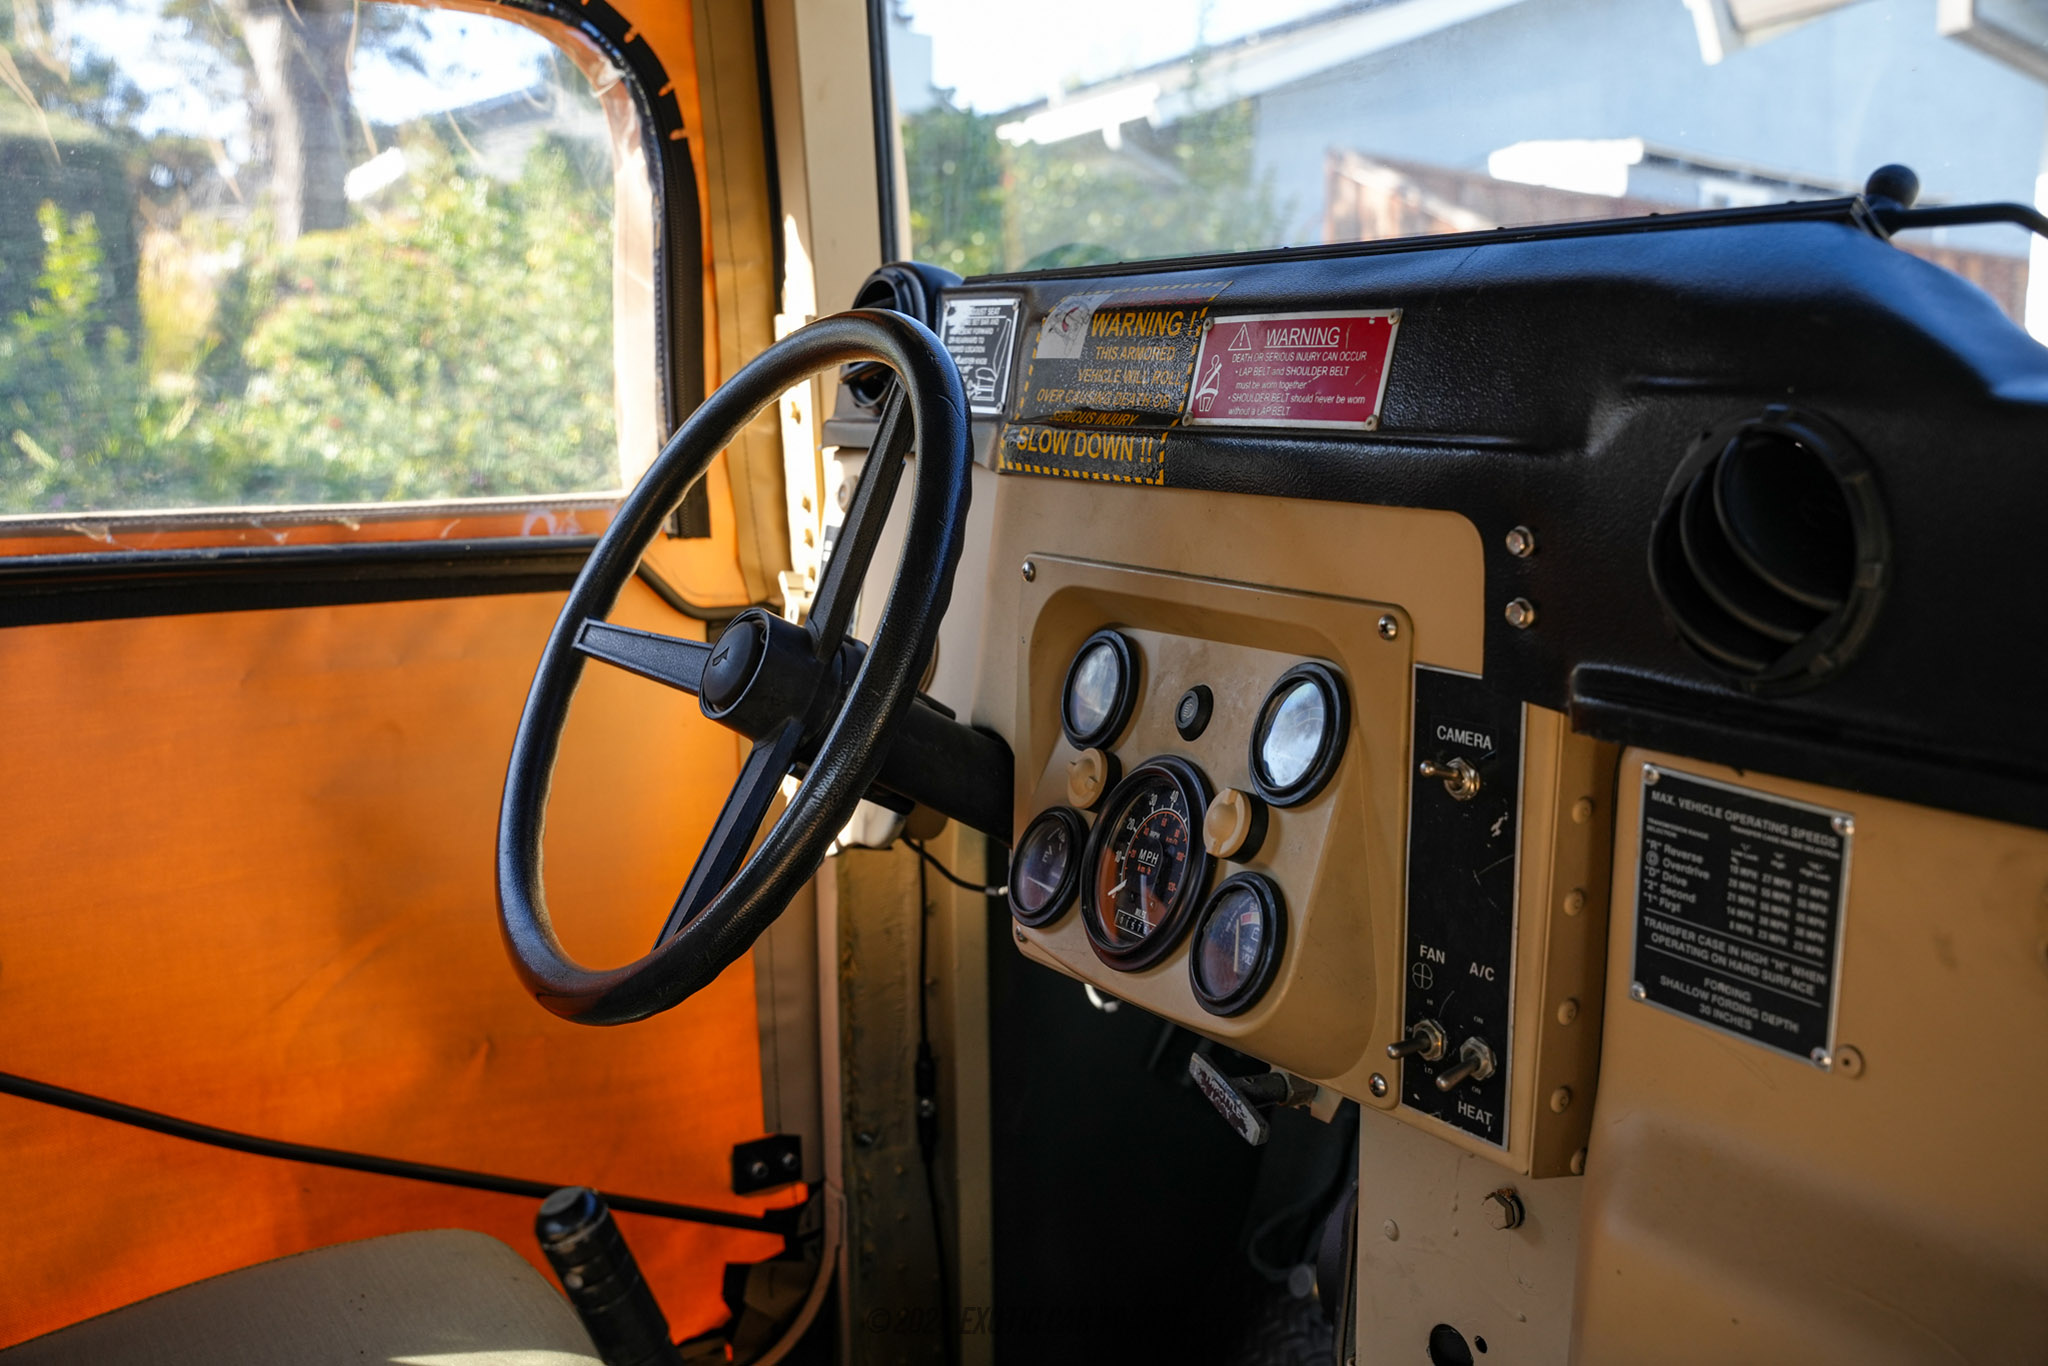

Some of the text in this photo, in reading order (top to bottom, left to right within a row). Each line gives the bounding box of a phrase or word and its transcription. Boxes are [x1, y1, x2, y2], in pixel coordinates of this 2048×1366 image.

[1091, 311, 1184, 337] WARNING
[1266, 327, 1340, 346] WARNING
[1095, 346, 1176, 361] THIS ARMORED
[1232, 351, 1368, 363] DEATH OR SERIOUS INJURY CAN OCCUR
[1078, 369, 1183, 385] VEHICLE WILL ROLL
[1253, 367, 1271, 376] BELT
[1271, 367, 1286, 376] and
[1285, 366, 1328, 376] SHOULDER
[1329, 366, 1350, 376] BELT
[1235, 381, 1251, 390] must
[1251, 381, 1260, 389] be
[1279, 381, 1307, 391] together
[1036, 388, 1171, 408] OVER CAUSING DEATH OR
[1270, 393, 1290, 403] BELT
[1290, 393, 1313, 403] should
[1314, 395, 1335, 404] never
[1335, 394, 1346, 404] be
[1347, 396, 1366, 404] worn
[1052, 410, 1139, 426] SERIOUS INJURY
[1228, 406, 1250, 415] without
[1256, 407, 1272, 416] LAP
[1272, 407, 1290, 416] BELT
[1017, 426, 1071, 455] SLOW
[1074, 432, 1135, 461] DOWN
[1436, 725, 1492, 750] CAMERA
[1126, 817, 1135, 831] 20
[1651, 790, 1838, 849] MAX. VEHICLE OPERATING SPEEDS
[1138, 849, 1160, 865] MPH
[1663, 843, 1704, 864] Reverse
[1662, 857, 1710, 880] Overdrive
[1662, 870, 1688, 887] Drive
[1660, 883, 1697, 904] Second
[1658, 897, 1681, 913] First
[1644, 916, 1696, 942] TRANSFER
[1697, 934, 1726, 951] CASE
[1727, 944, 1739, 956] IN
[1740, 947, 1769, 966] HIGH
[1791, 963, 1827, 985] WHEN
[1419, 944, 1495, 982] FAN A/C
[1651, 933, 1816, 997] OPERATING ON HARD SURFACE
[1703, 977, 1752, 1003] FORDING
[1660, 975, 1800, 1034] SHALLOW FORDING DEPTH
[1713, 1008, 1753, 1031] INCHES
[1457, 1101, 1493, 1125] HEAT
